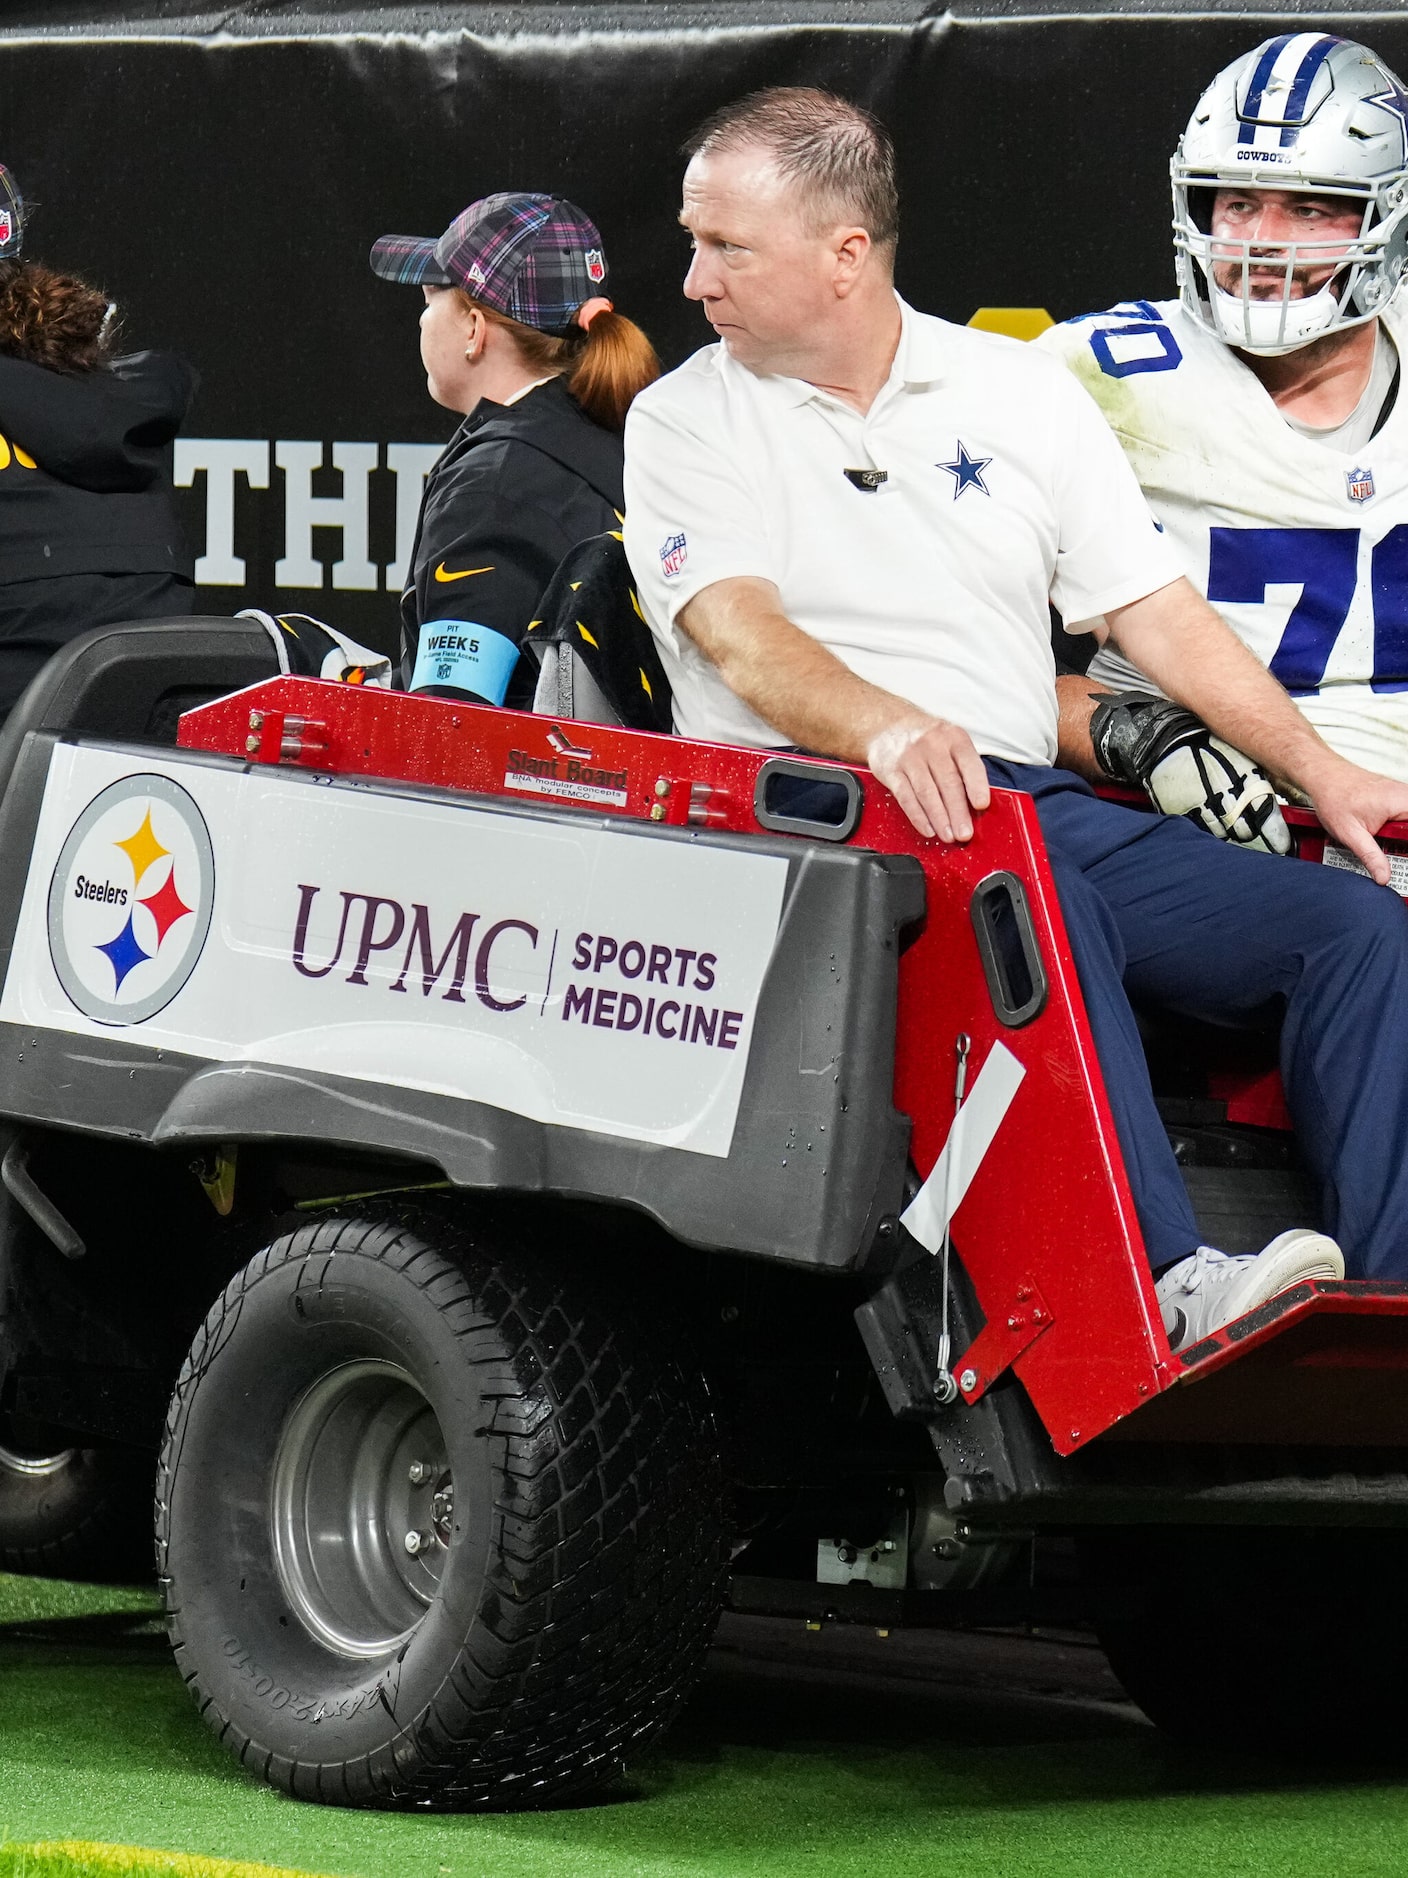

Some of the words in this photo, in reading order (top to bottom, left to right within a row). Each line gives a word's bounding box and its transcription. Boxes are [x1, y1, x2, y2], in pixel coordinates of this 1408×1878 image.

[1351, 481, 1373, 499] NFL
[664, 547, 687, 575] NFL
[446, 624, 460, 633] PIT
[427, 635, 467, 651] WEEK
[468, 639, 480, 654] 5
[506, 749, 560, 778] Slant
[566, 758, 629, 789] Board
[511, 773, 532, 783] BNA
[535, 778, 573, 789] modular
[576, 784, 622, 798] concepts
[540, 785, 553, 795] by
[555, 786, 591, 800] FEMCO
[74, 874, 129, 906] Steelers
[292, 884, 539, 1013] UPMC
[571, 932, 718, 991] SPORTS
[561, 984, 744, 1050] MEDICINE
